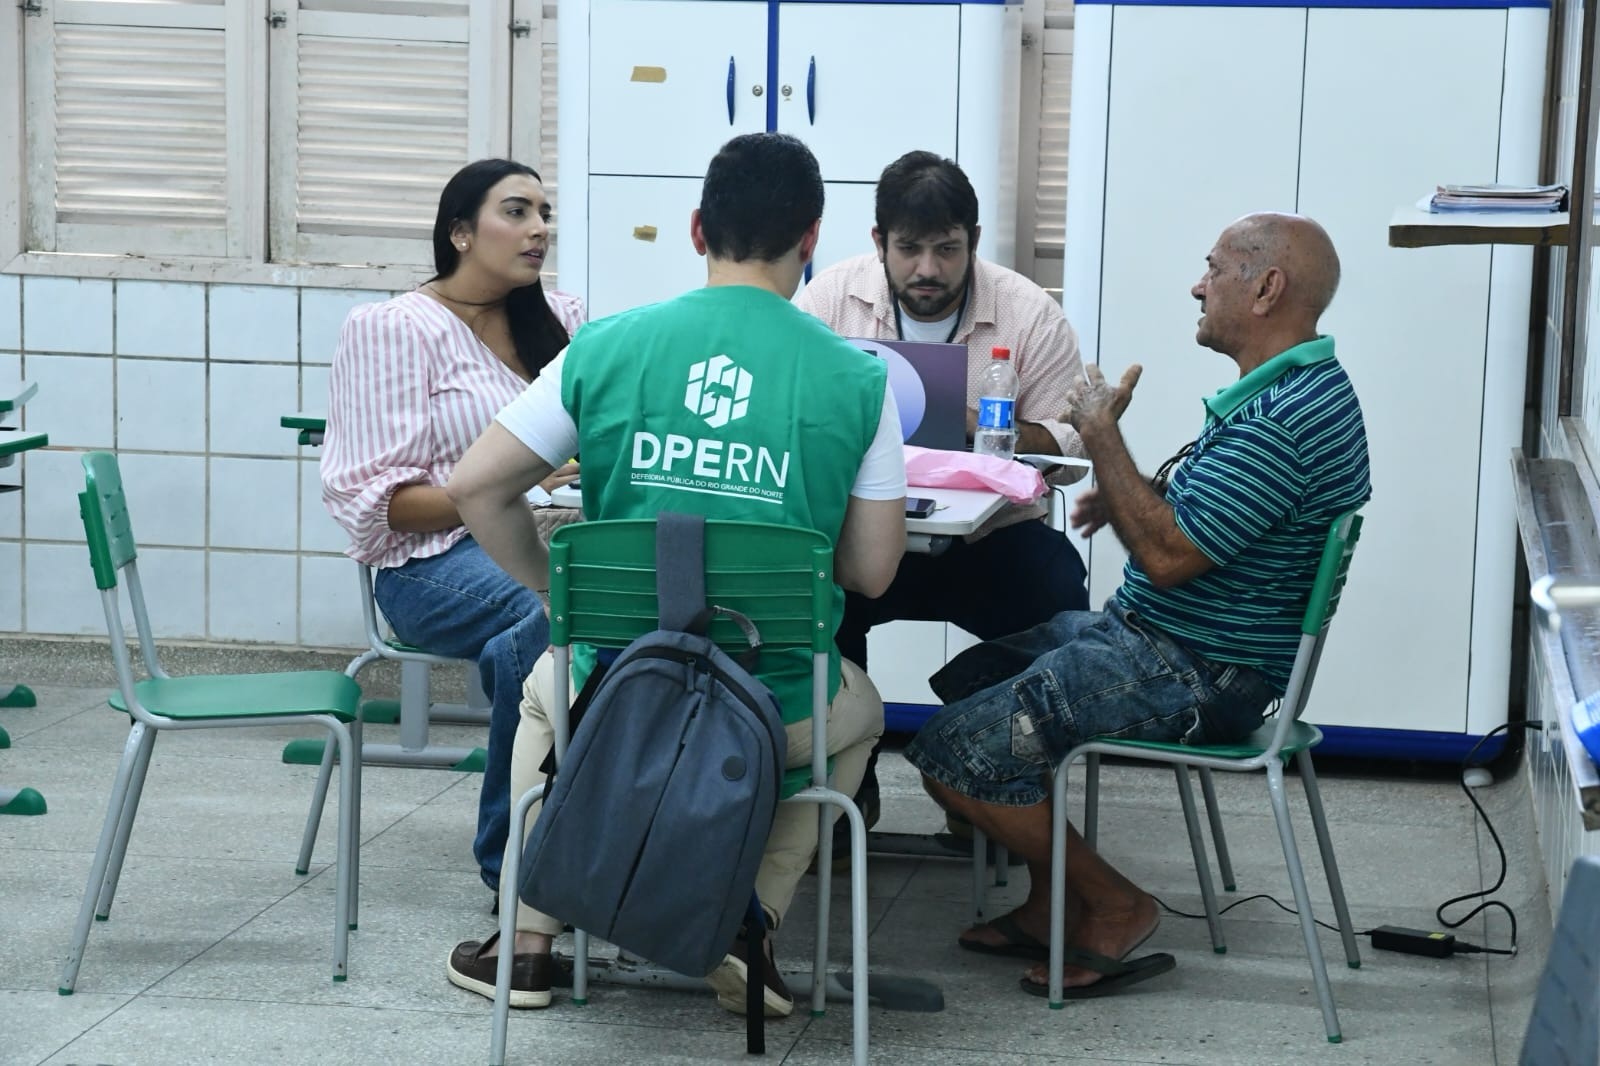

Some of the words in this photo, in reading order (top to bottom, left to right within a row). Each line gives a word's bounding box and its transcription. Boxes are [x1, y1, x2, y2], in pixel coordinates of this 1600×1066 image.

[631, 431, 790, 488] DPERN
[666, 475, 694, 486] PÚBLICA
[707, 481, 720, 489] RIO
[720, 483, 748, 493] GRANDE
[761, 489, 784, 499] NORTE
